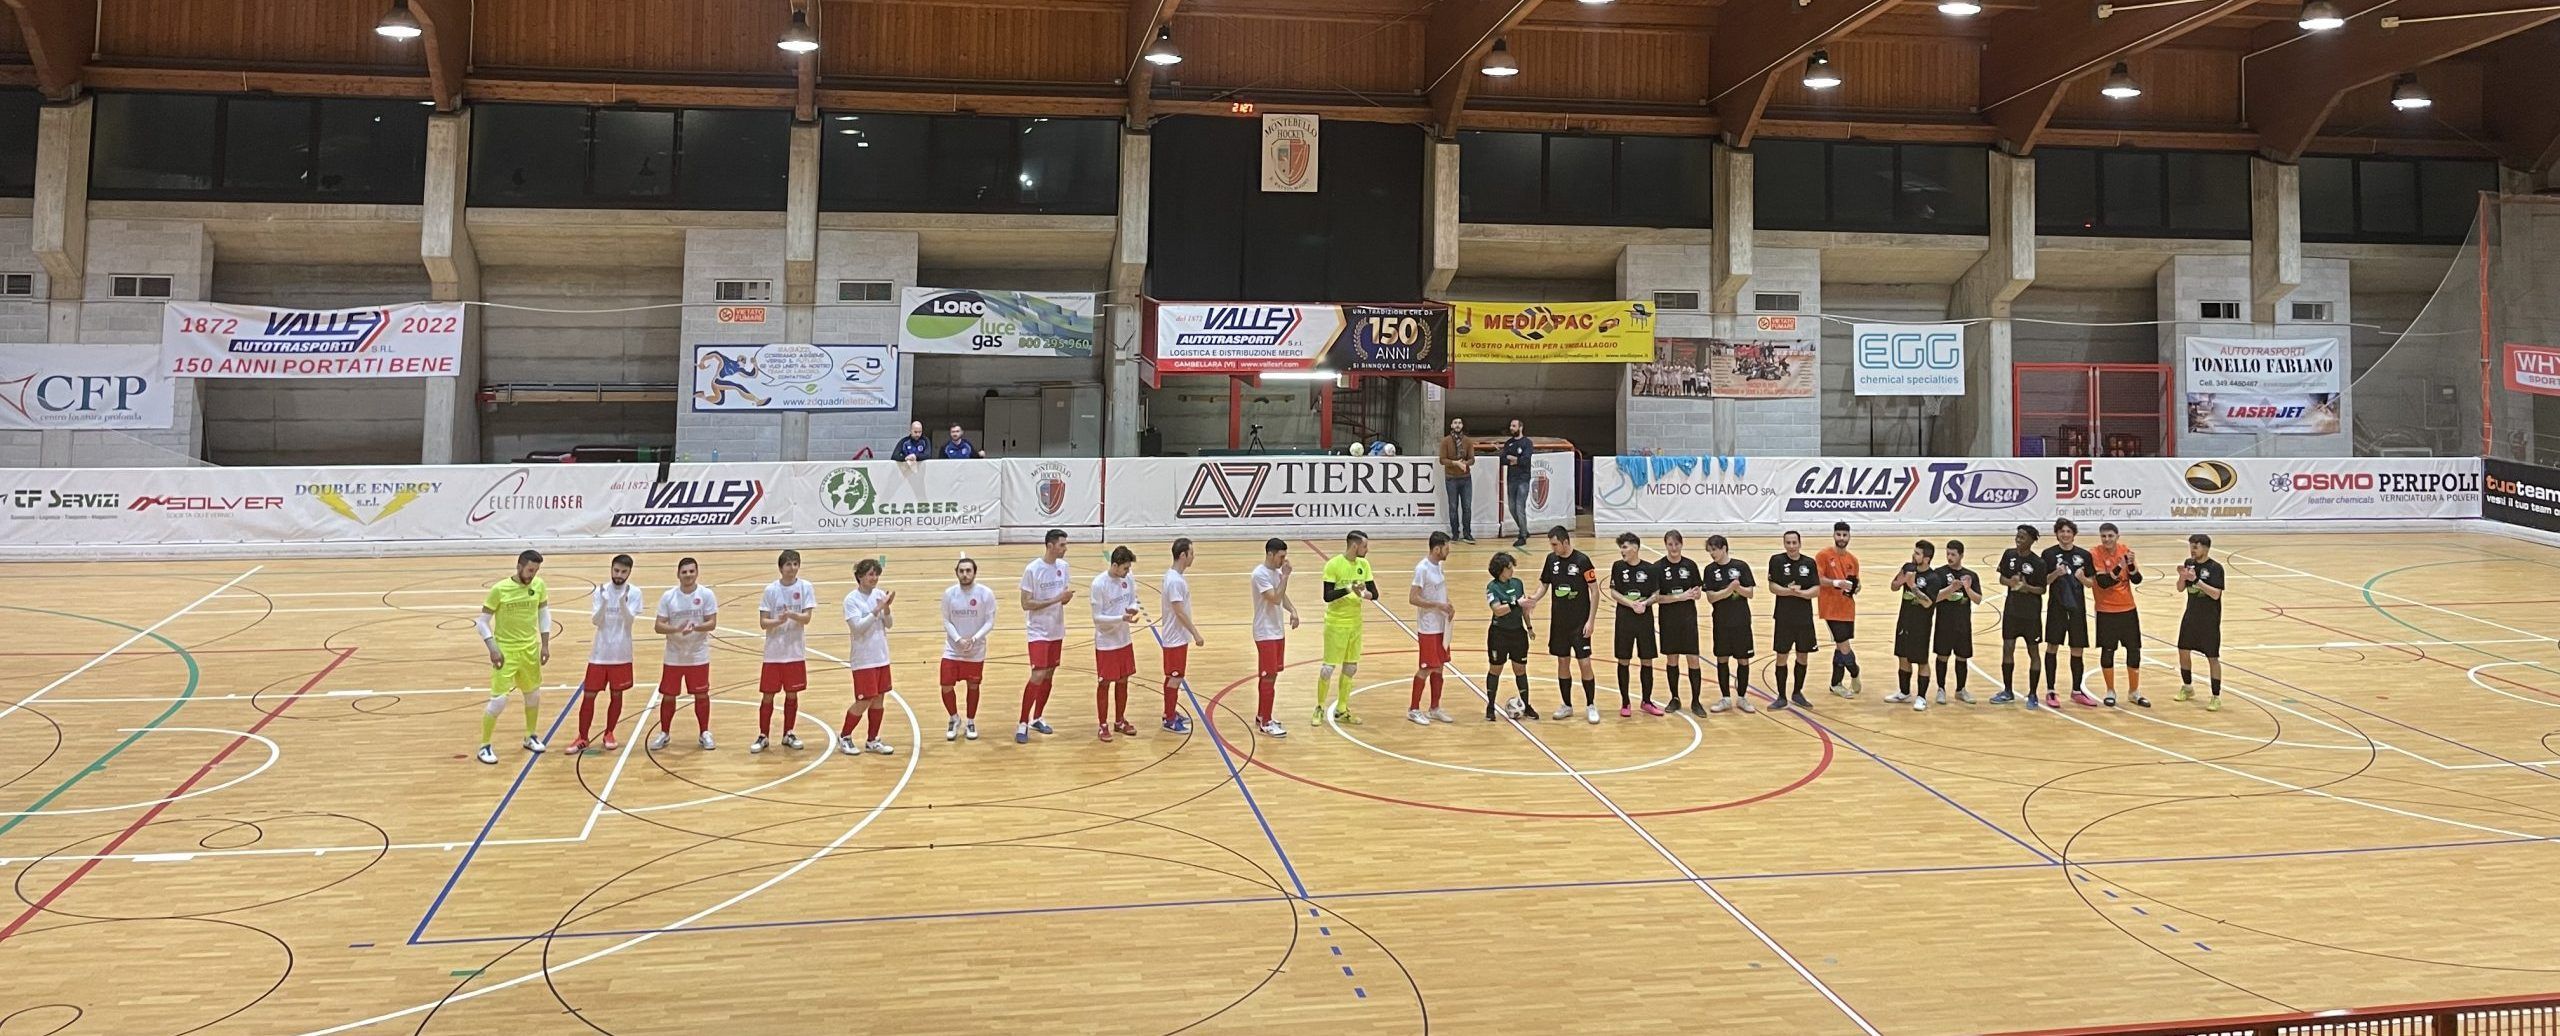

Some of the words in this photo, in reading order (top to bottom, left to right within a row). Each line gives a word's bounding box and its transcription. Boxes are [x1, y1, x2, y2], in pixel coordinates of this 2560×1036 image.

[1264, 118, 1318, 137] MONTEBELLO
[1277, 129, 1304, 138] HOCKEY
[934, 300, 985, 315] LORO
[180, 317, 239, 335] 1872
[264, 311, 380, 337] VALLE
[401, 317, 457, 334] 2022
[1204, 307, 1289, 330] VALLE
[1483, 313, 1594, 331] MEDIAPAC
[980, 317, 1016, 336] luce
[1369, 317, 1419, 345] 150
[232, 340, 355, 352] AUTOTRASPORTI
[972, 334, 1003, 351] gas
[1068, 338, 1090, 349] 960
[1180, 335, 1275, 345] AUTOTRASPORTI
[1460, 341, 1468, 349] IL
[1375, 346, 1410, 360] ANNI
[1858, 333, 1960, 369] EGG
[2220, 346, 2306, 356] AUTOTRASPORTI
[173, 357, 214, 373] 150
[218, 358, 276, 374] ANNI
[282, 358, 383, 374] PORTATI
[389, 357, 454, 373] BENE
[1361, 362, 1391, 370] RINNOVA
[2192, 357, 2261, 373] TONELLO
[2266, 357, 2333, 373] FABIANO
[1860, 375, 1904, 384] chemical
[1906, 375, 1959, 386] specialties
[36, 375, 148, 412] CFP
[2226, 406, 2306, 419] LASERJET
[610, 481, 627, 490] dal
[627, 481, 649, 490] 1872
[1276, 462, 1436, 495] TIERRE
[1795, 466, 1893, 496] G.A.V.A.
[2292, 473, 2374, 491] OSMO
[2378, 473, 2479, 493] PERIPOLI
[295, 483, 367, 496] DOUBLE
[371, 482, 443, 495] ENERGY
[644, 480, 752, 509] VALLE
[1646, 483, 1692, 497] MEDIO
[1694, 483, 1759, 497] CHIAMPO
[2080, 489, 2101, 499] GSC
[2103, 488, 2142, 499] GROUP
[166, 496, 284, 511] SOLVER
[356, 497, 380, 508] s.r.l.
[489, 494, 583, 510] ELETTROLASER
[2170, 497, 2253, 505] AUTOTRASPORTI
[2307, 495, 2336, 505] leather
[2335, 495, 2375, 505] chemicals
[2379, 493, 2438, 503] VERNICIATURA
[2438, 494, 2445, 502] A
[2446, 493, 2479, 503] POLVERI
[878, 502, 959, 515] CLABER
[1295, 503, 1380, 519] CHIMICA
[1384, 503, 1417, 518] s.r.l.
[2055, 506, 2068, 517] for
[2072, 505, 2106, 518] leather,
[2109, 505, 2121, 516] for
[2126, 508, 2143, 518] you
[2514, 499, 2530, 511] tuo
[2531, 502, 2552, 515] team
[615, 512, 730, 527] AUTOTRASPORTI
[818, 518, 848, 528] ONLY
[852, 516, 913, 528] SUPERIOR
[916, 514, 984, 526] EQUIPMENT
